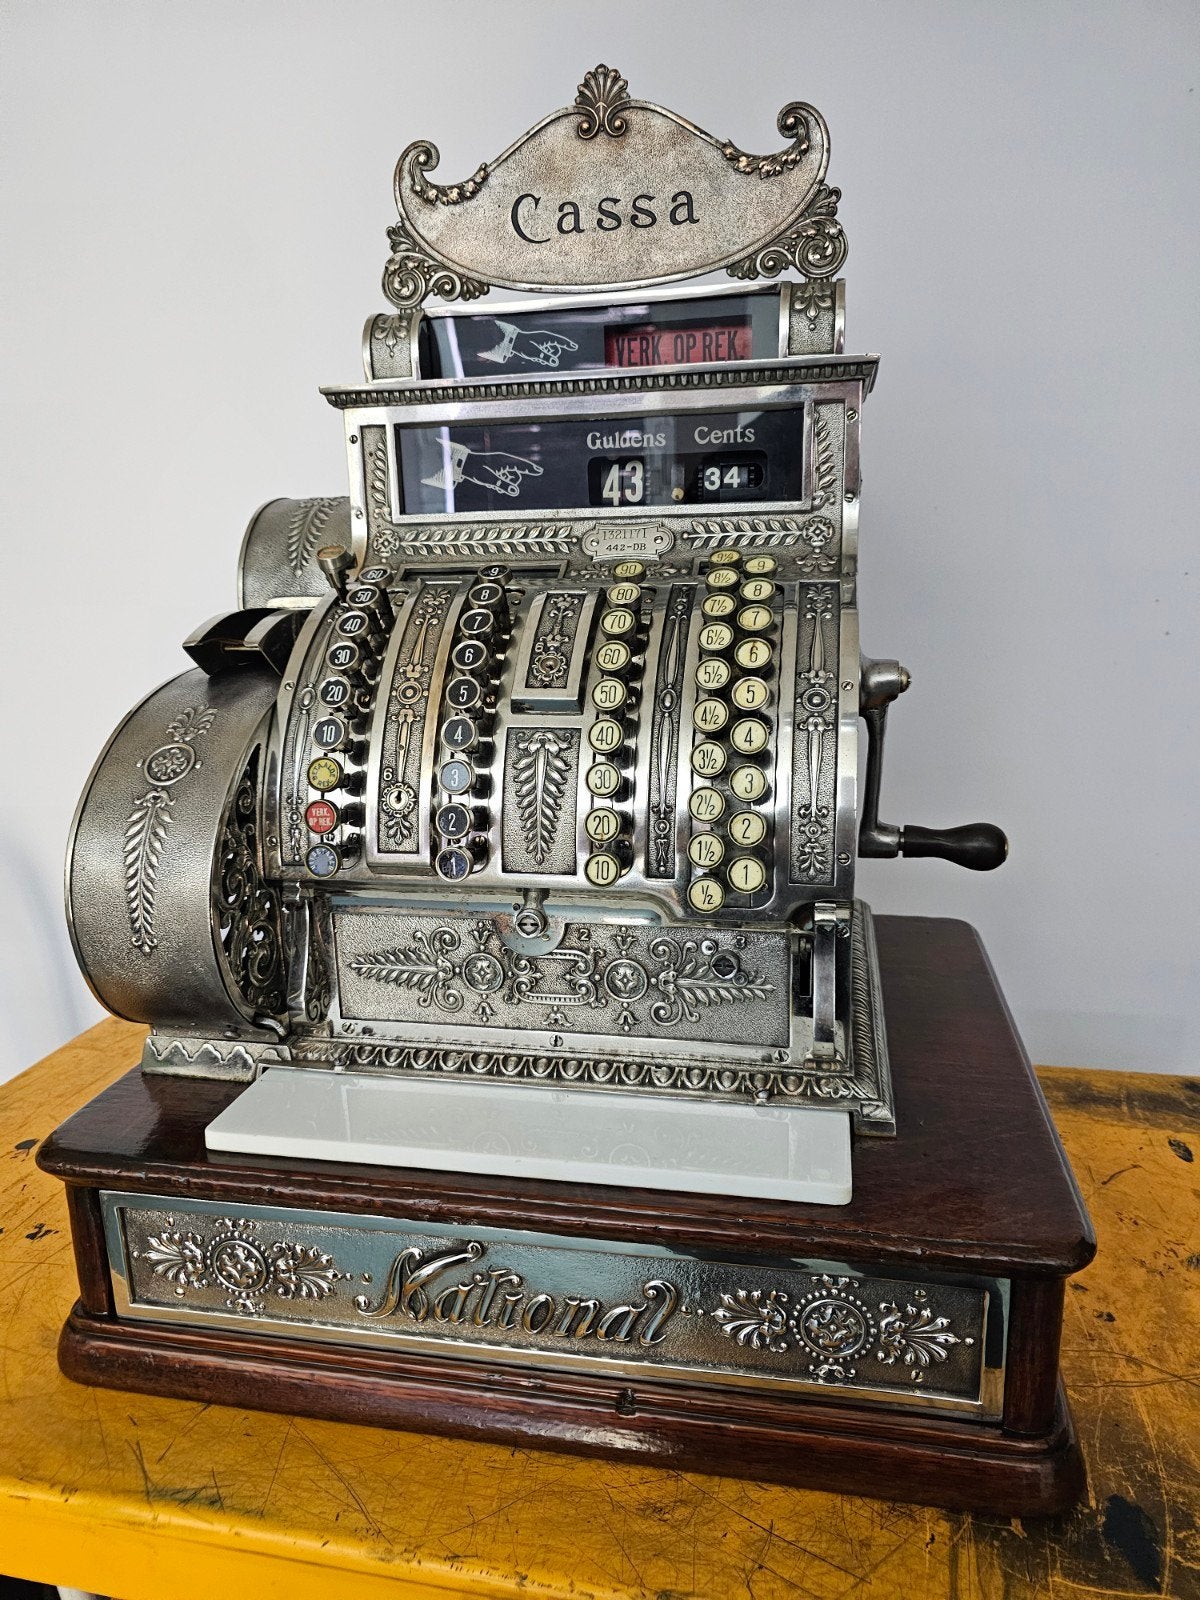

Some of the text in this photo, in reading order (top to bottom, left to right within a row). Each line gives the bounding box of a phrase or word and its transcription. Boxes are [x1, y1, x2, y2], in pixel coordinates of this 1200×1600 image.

[511, 191, 700, 243] Cassa
[614, 330, 745, 367] VERK. OP REK.
[586, 431, 667, 450] Guldens
[694, 425, 756, 445] Cents
[602, 460, 644, 506] 43
[704, 465, 741, 491] 34
[605, 543, 647, 551] 442-DB
[366, 570, 384, 579] 60
[490, 567, 500, 576] 9
[621, 565, 637, 575] 90
[757, 560, 766, 571] 9
[355, 591, 371, 602] 50
[480, 589, 490, 600] 8
[616, 588, 633, 600] 80
[753, 583, 763, 596] 8
[343, 618, 360, 631] 40
[473, 616, 482, 629] 7
[609, 614, 627, 629] 70
[751, 611, 760, 625] 7
[334, 649, 350, 664] 30
[464, 648, 474, 662] 6
[603, 648, 620, 664] 60
[749, 645, 758, 663] 6
[326, 685, 342, 701] 20
[459, 685, 468, 701] 5
[600, 685, 617, 704] 50
[745, 684, 755, 703] 5
[322, 725, 335, 743] 10
[453, 725, 463, 743] 4
[595, 726, 614, 746] 40
[744, 726, 754, 746] 4
[384, 767, 393, 781] 6
[451, 768, 459, 786] 3
[594, 769, 611, 789] 30
[745, 773, 753, 793] 3
[448, 813, 457, 831] 2
[593, 815, 610, 836] 20
[742, 818, 751, 839] 2
[594, 860, 610, 881] 10
[579, 928, 590, 941] 2
[355, 1241, 679, 1346] National
